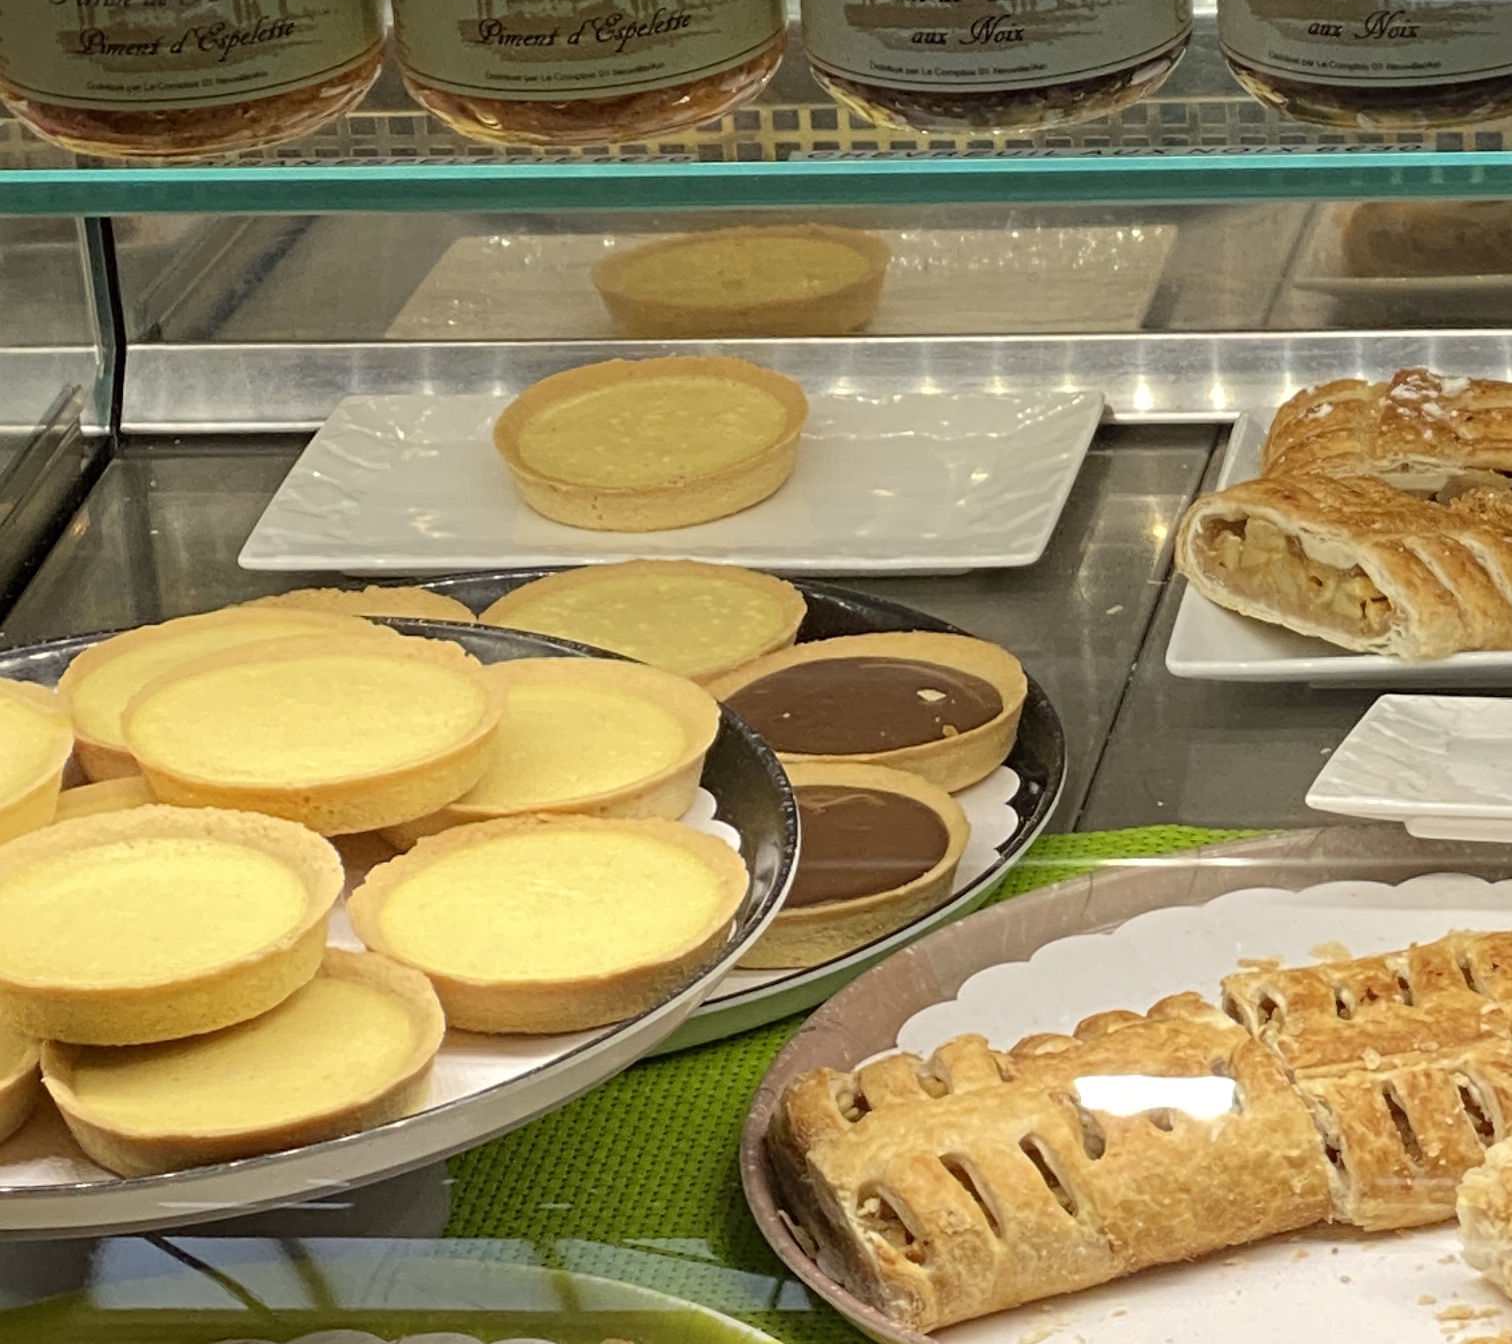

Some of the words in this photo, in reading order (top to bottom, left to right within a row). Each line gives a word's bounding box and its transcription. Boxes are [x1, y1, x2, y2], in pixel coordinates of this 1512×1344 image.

[478, 18, 563, 47] Piment
[911, 28, 949, 45] aux
[959, 13, 1026, 45] Noix
[1308, 19, 1344, 38] aux
[1354, 9, 1421, 40] Noix
[79, 26, 162, 56] Piment
